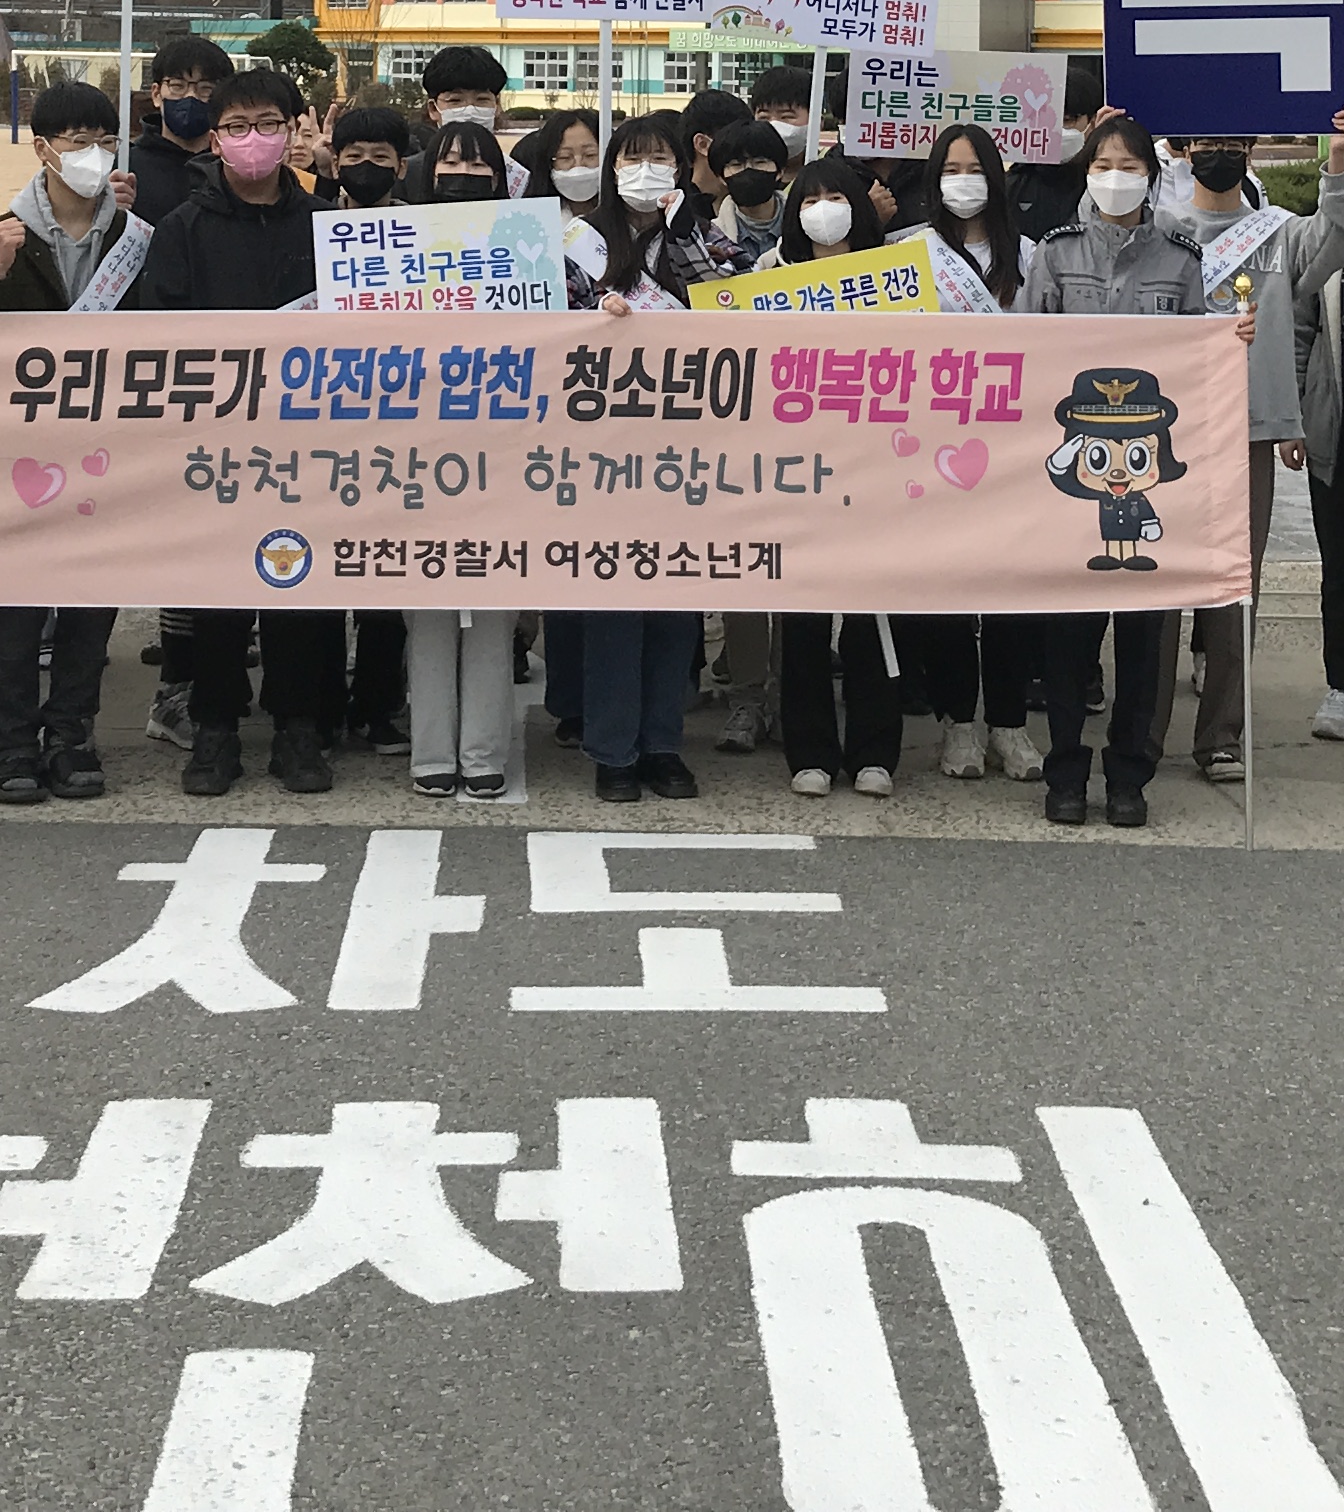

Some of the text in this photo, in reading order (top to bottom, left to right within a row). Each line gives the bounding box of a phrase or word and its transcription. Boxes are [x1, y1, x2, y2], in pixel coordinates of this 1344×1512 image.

[885, 0, 927, 24] 멈춰!
[820, 19, 925, 47] 모두가 멈춰!
[861, 58, 939, 88] 우리는
[861, 90, 1022, 124] 다른 친구들을
[857, 122, 1049, 156] 괴롭히지 것이다
[329, 219, 416, 253] 우리는
[332, 247, 515, 288] 다른 친구들을
[485, 280, 552, 311] 것이다
[797, 283, 835, 312] 가슴
[840, 274, 878, 310] 푸른
[882, 265, 919, 301] 건강
[9, 344, 1025, 425] 우리 모두가 안전한 합천, 청소년이 행복한 학교
[184, 443, 852, 510] 합천경찰이 함께합니다.
[333, 537, 783, 581] 합천경찰서 여성청소년계
[27, 827, 888, 1015] 차도
